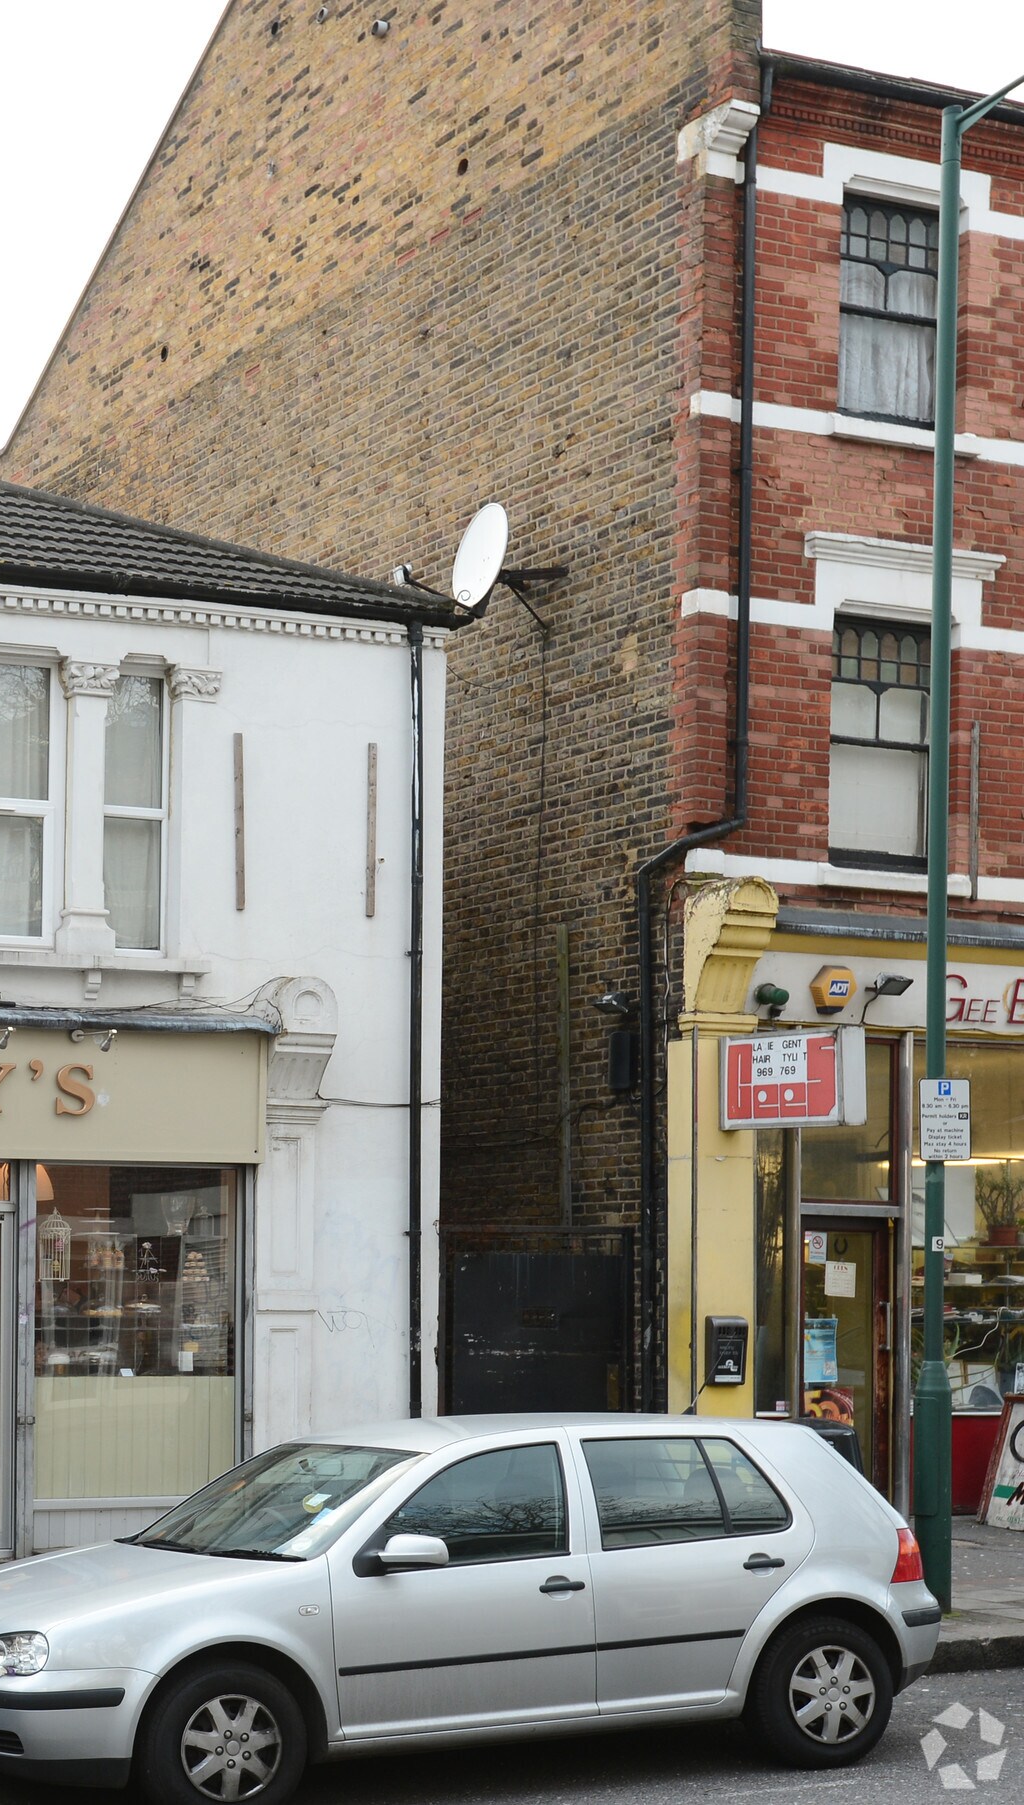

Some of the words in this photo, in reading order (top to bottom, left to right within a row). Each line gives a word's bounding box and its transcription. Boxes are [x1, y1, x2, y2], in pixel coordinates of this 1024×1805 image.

[830, 982, 849, 994] ADT
[752, 1055, 771, 1064] HAIR
[756, 1067, 773, 1077] 969
[780, 1066, 796, 1075] 769
[928, 1134, 946, 1142] Display
[936, 1239, 944, 1250] 9
